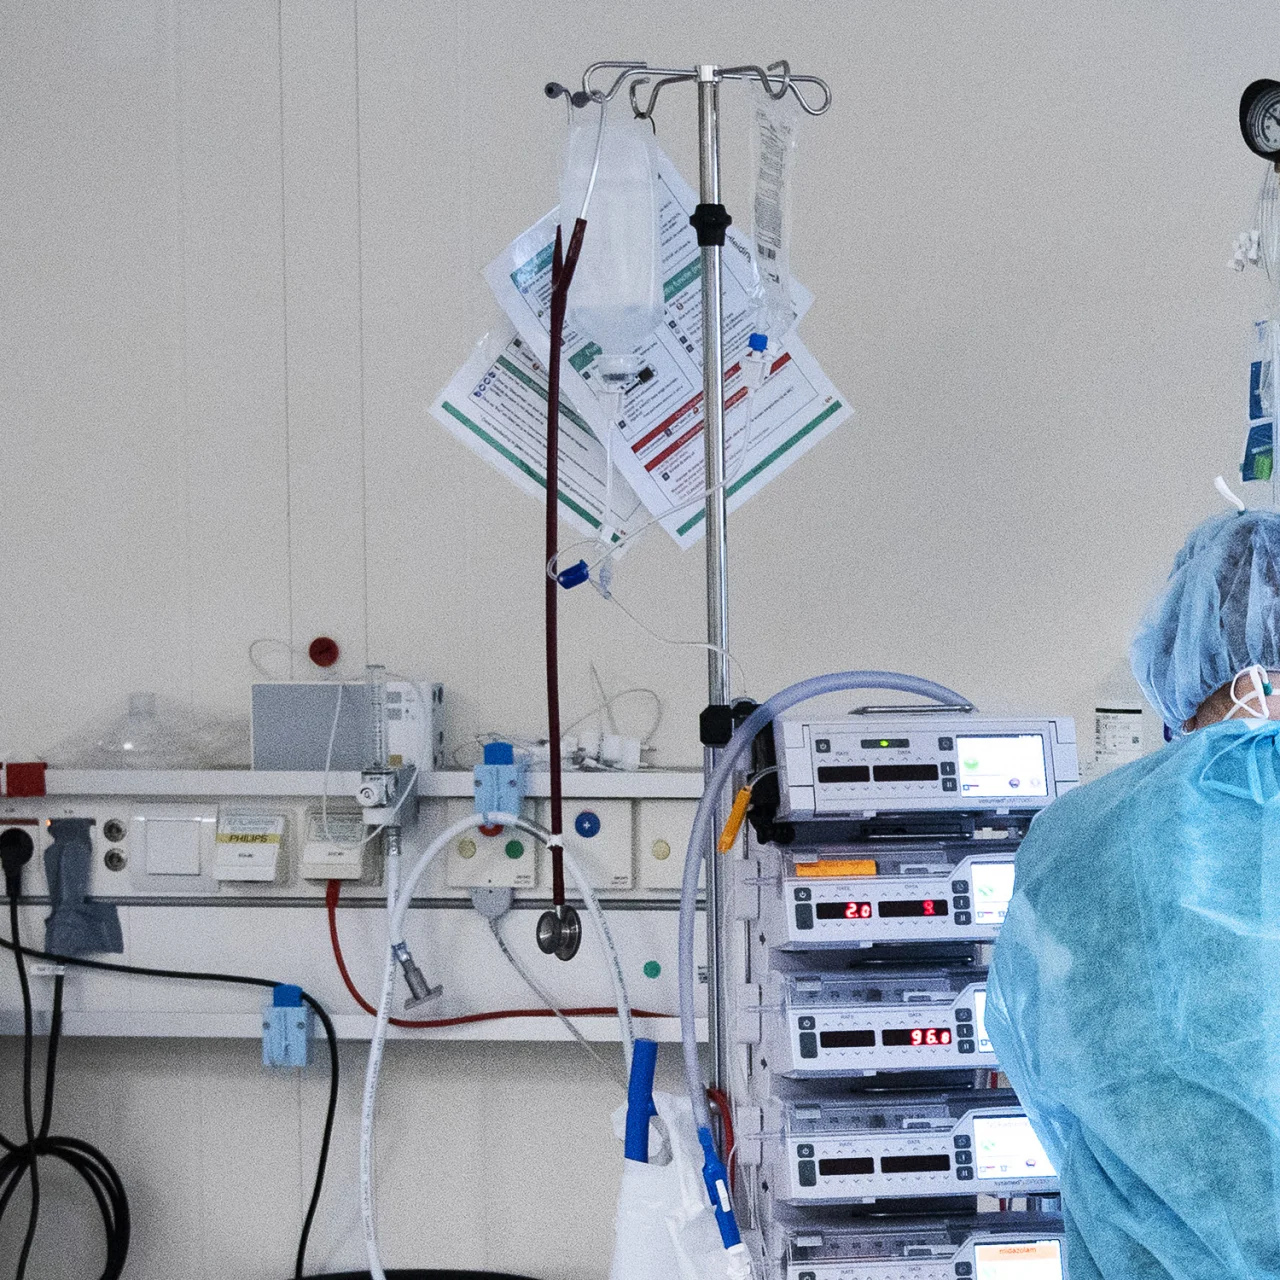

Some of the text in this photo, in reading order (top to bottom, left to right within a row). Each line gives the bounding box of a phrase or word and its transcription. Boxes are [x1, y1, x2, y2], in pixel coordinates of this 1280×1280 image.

[229, 834, 268, 843] PHILIPS
[845, 902, 871, 918] 2.0
[911, 1029, 951, 1046] 96.8
[999, 1246, 1037, 1255] midazolam
